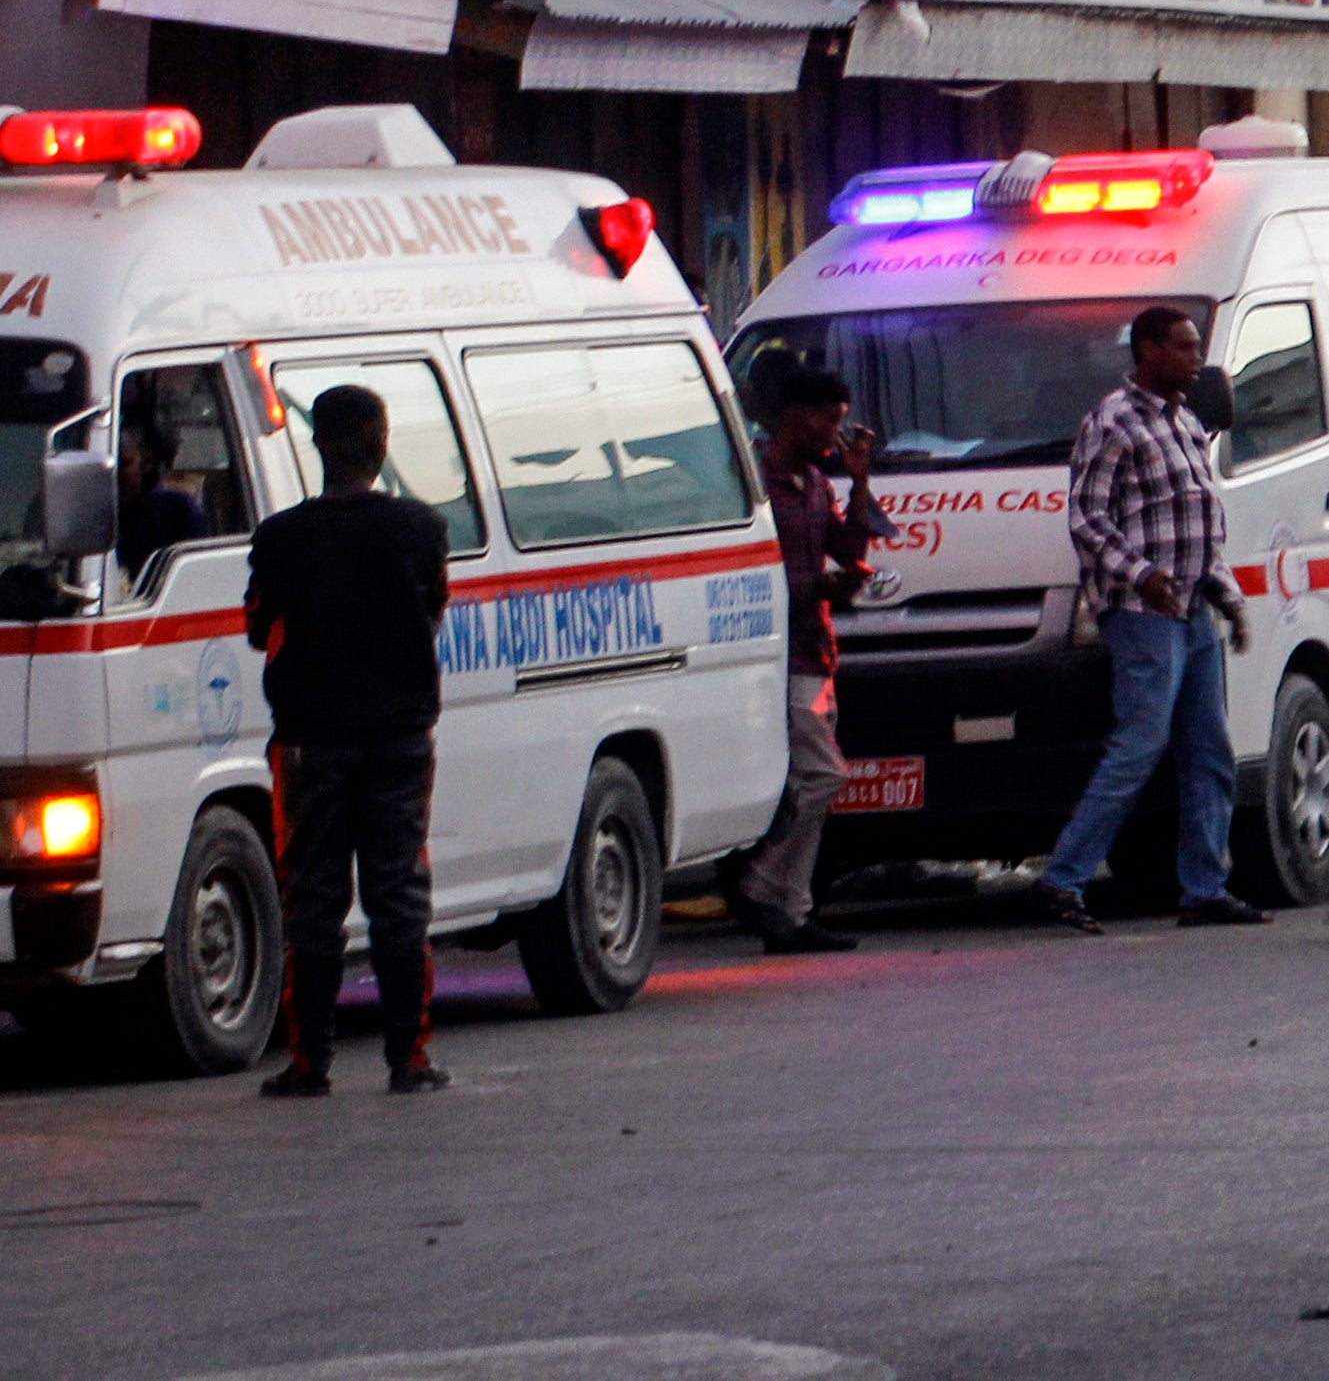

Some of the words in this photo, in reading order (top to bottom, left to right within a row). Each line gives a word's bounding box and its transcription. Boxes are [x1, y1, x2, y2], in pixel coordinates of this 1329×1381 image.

[259, 194, 532, 267] AMBULANCE
[816, 251, 1006, 280] GARGAARKA
[1014, 248, 1081, 267] DEG
[1088, 248, 1178, 267] DEGA
[997, 490, 1069, 514] CAS
[495, 586, 550, 670] ABDI
[553, 571, 664, 660] HOSPITAL
